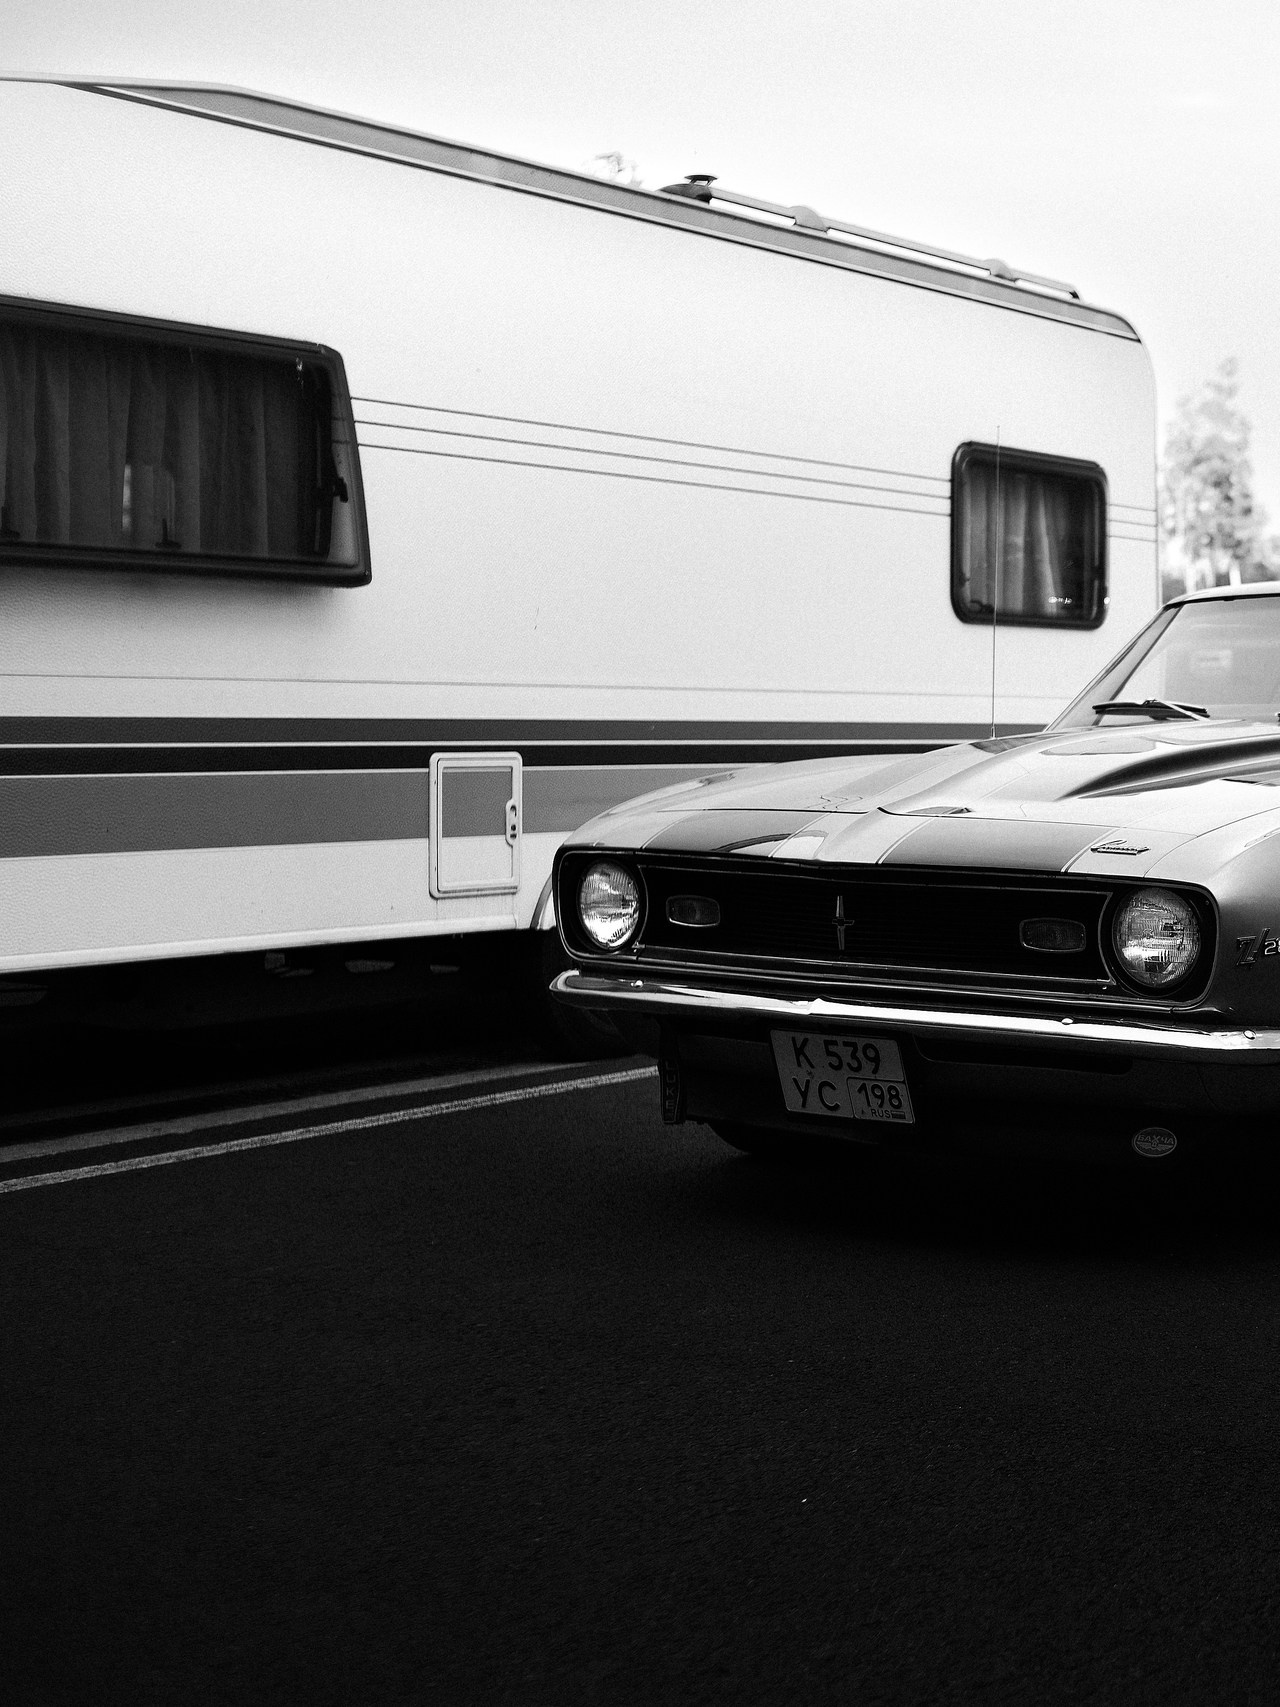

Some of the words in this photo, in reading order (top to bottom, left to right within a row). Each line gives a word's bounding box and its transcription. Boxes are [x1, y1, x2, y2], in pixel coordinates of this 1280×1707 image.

[823, 1039, 881, 1075] 539
[856, 1082, 903, 1109] 198
[870, 1108, 892, 1119] RUS
